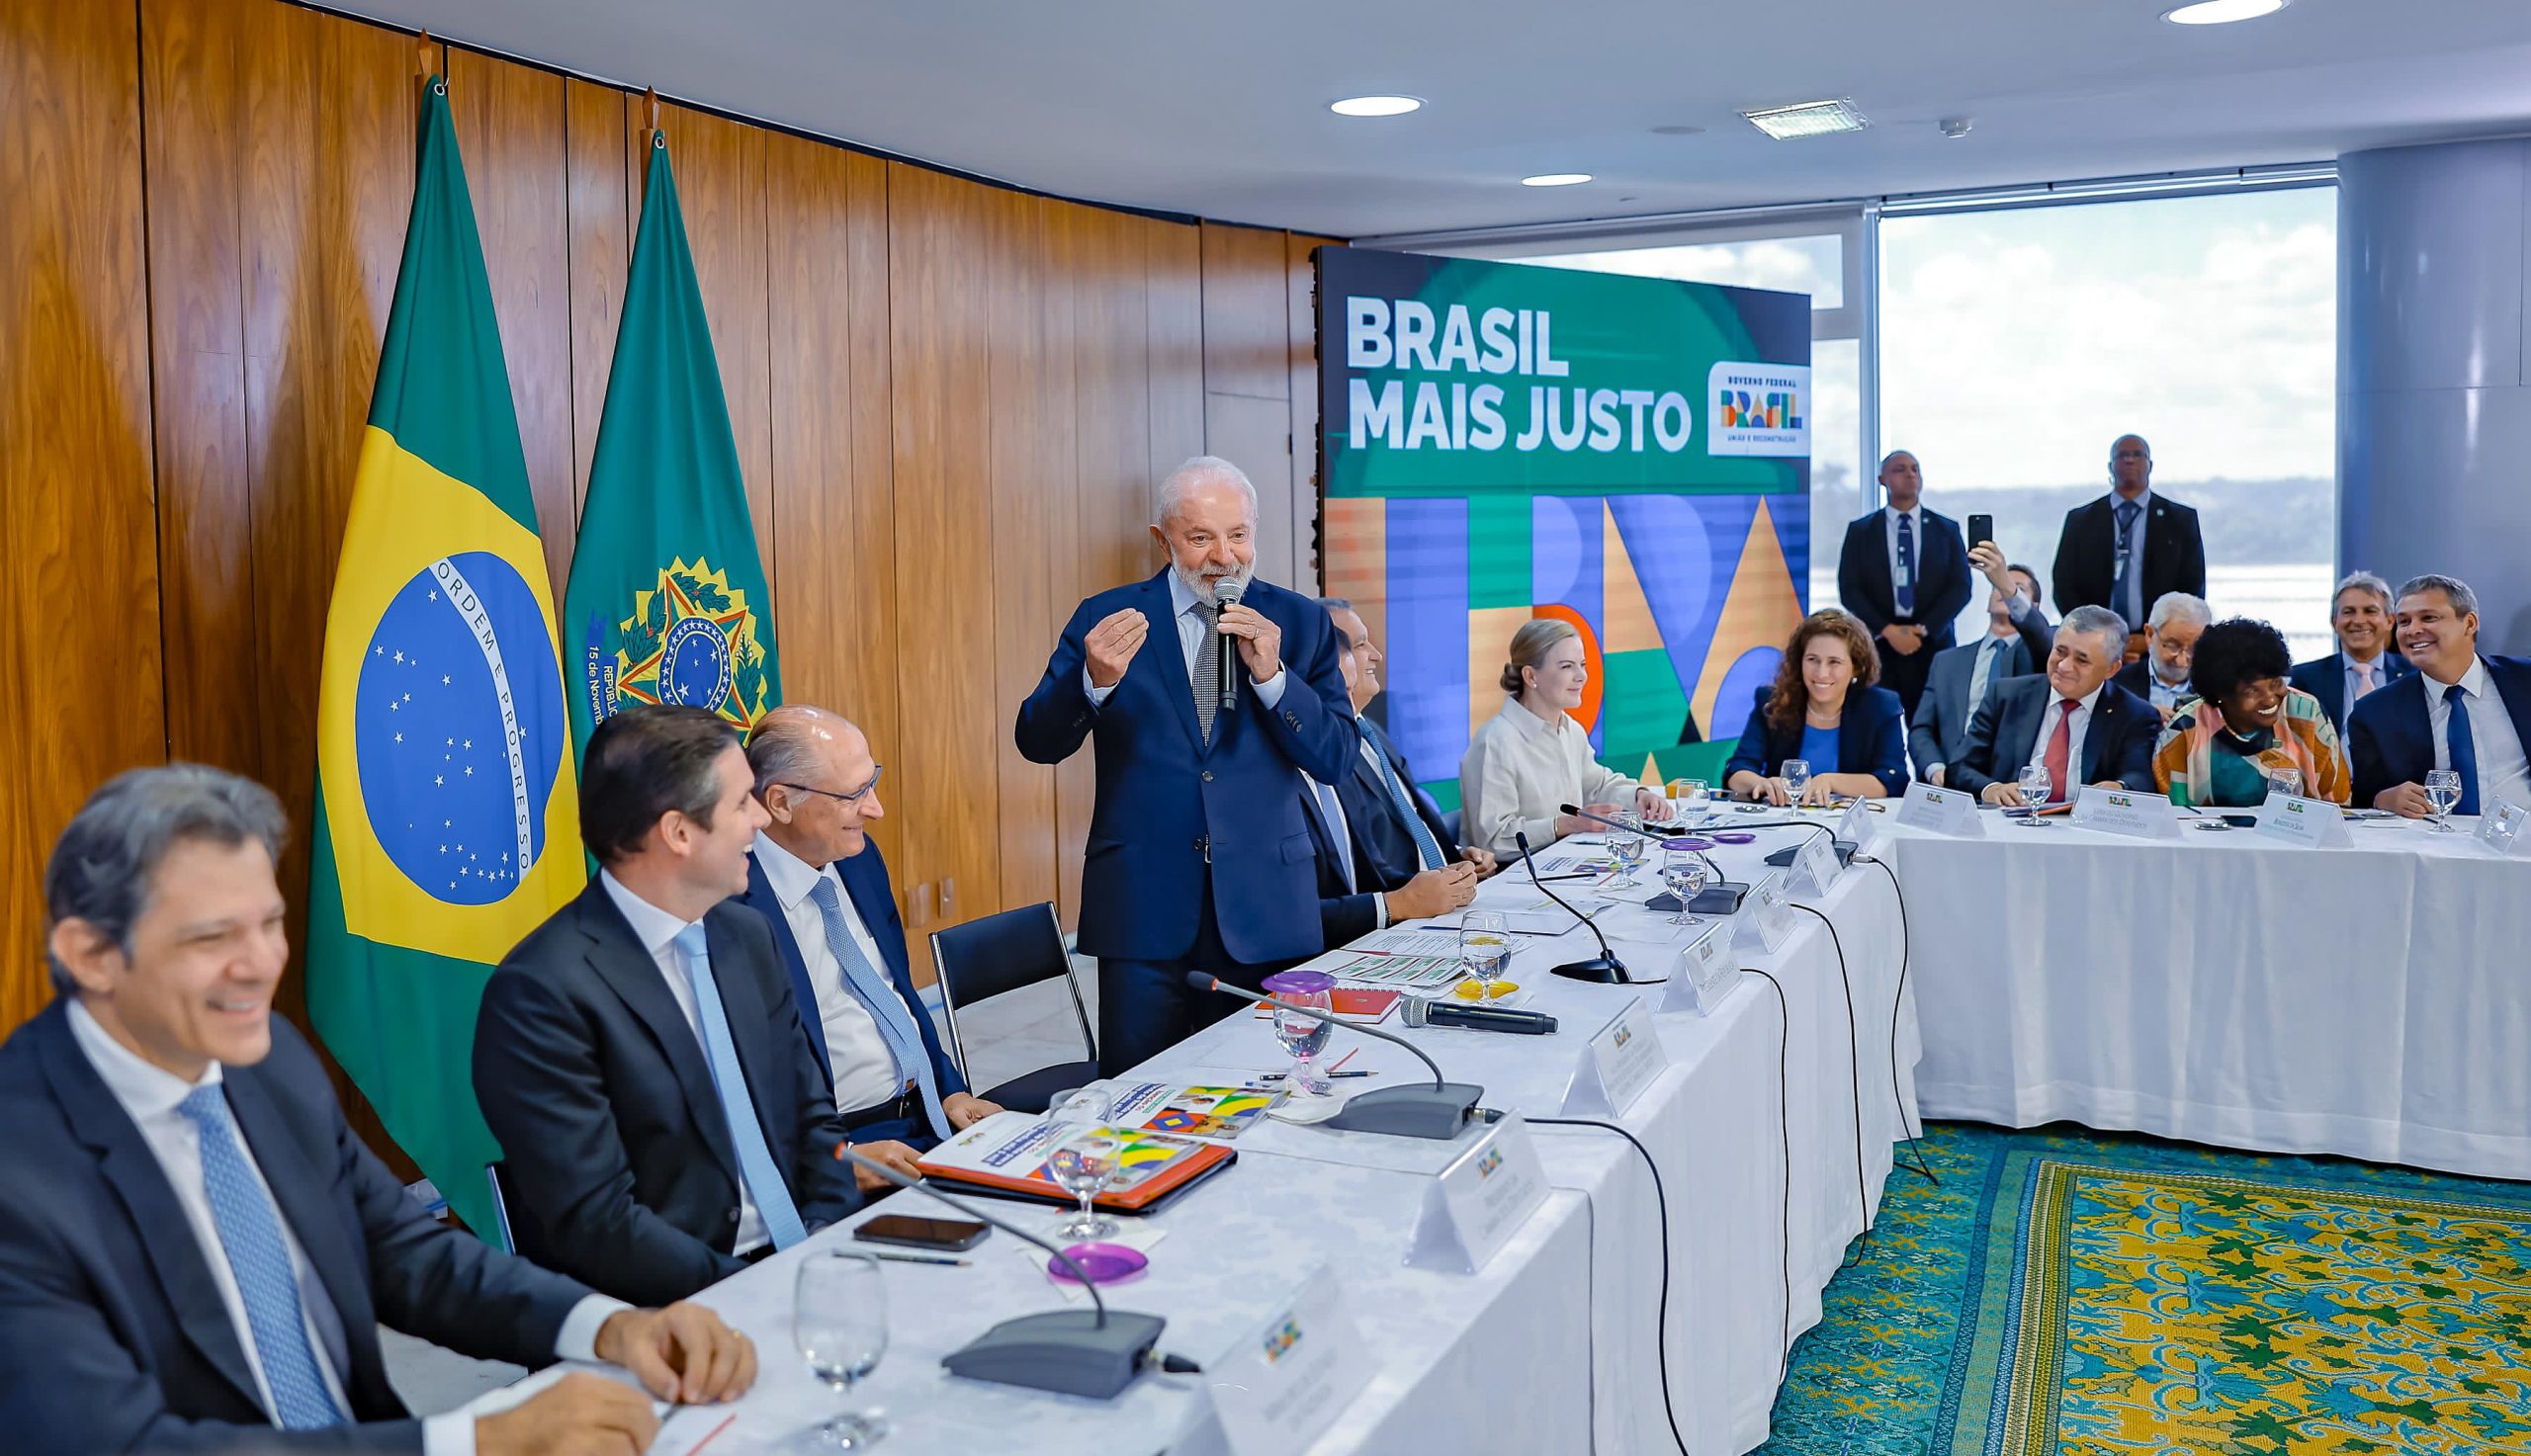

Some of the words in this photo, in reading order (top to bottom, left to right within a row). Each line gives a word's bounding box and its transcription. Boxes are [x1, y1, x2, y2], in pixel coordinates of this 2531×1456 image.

[1347, 296, 1570, 377] BRASIL
[1728, 377, 1762, 386] GOVERNO
[1766, 378, 1796, 387] FEDERAL
[1349, 378, 1508, 451] MAIS
[1516, 385, 1693, 453] JUSTO
[1720, 389, 1803, 430] BRASIL
[588, 645, 600, 659] 15
[588, 661, 599, 677] de
[437, 561, 495, 651] ORDEM
[494, 662, 503, 679] E
[500, 692, 529, 870] PROGRESSO
